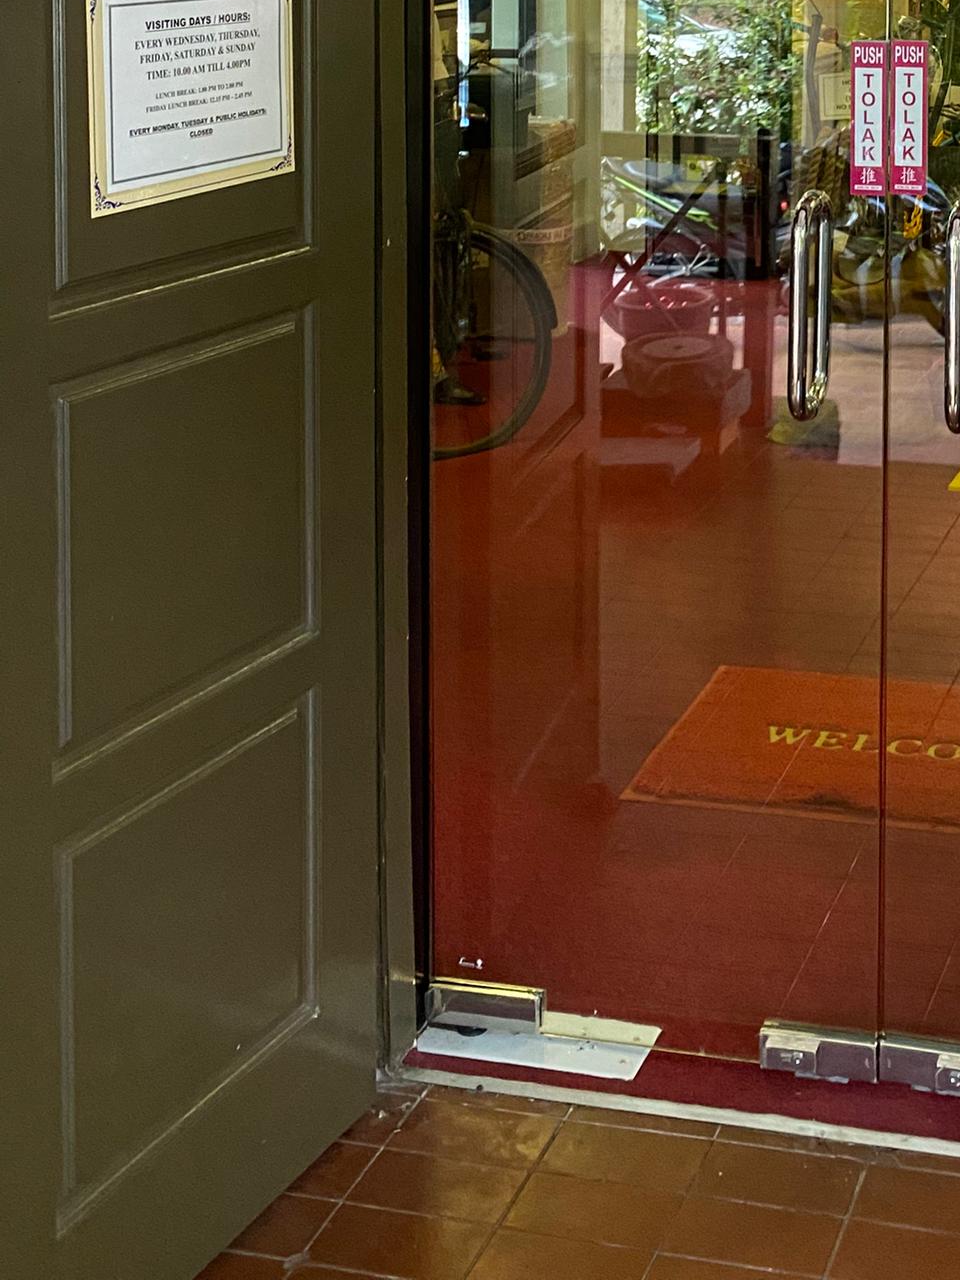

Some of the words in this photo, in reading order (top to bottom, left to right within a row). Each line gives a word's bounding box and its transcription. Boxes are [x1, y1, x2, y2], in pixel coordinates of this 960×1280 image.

[145, 18, 186, 31] VISITING
[189, 15, 212, 26] DAYS
[218, 12, 251, 24] HOURS:
[134, 39, 164, 51] EVERY
[165, 33, 217, 47] WEDNESDAY,
[217, 28, 260, 41] THURSDAY,
[139, 52, 173, 64] FRIDAY,
[174, 46, 217, 60] SATURDAY
[217, 45, 225, 55] &
[225, 42, 256, 54] SUNDAY
[854, 46, 883, 64] PUSH
[894, 46, 924, 64] PUSH
[147, 69, 172, 81] TIME:
[192, 64, 206, 75] AM
[206, 62, 225, 73] TILL
[129, 127, 151, 137] EVERY
[181, 117, 208, 128] TUESDAY
[215, 112, 237, 123] PUBLIC
[861, 73, 876, 162] TOLAK
[902, 72, 916, 161] TOLAK
[189, 128, 214, 138] CLOSED
[860, 167, 877, 184] 推
[900, 167, 917, 183] 推
